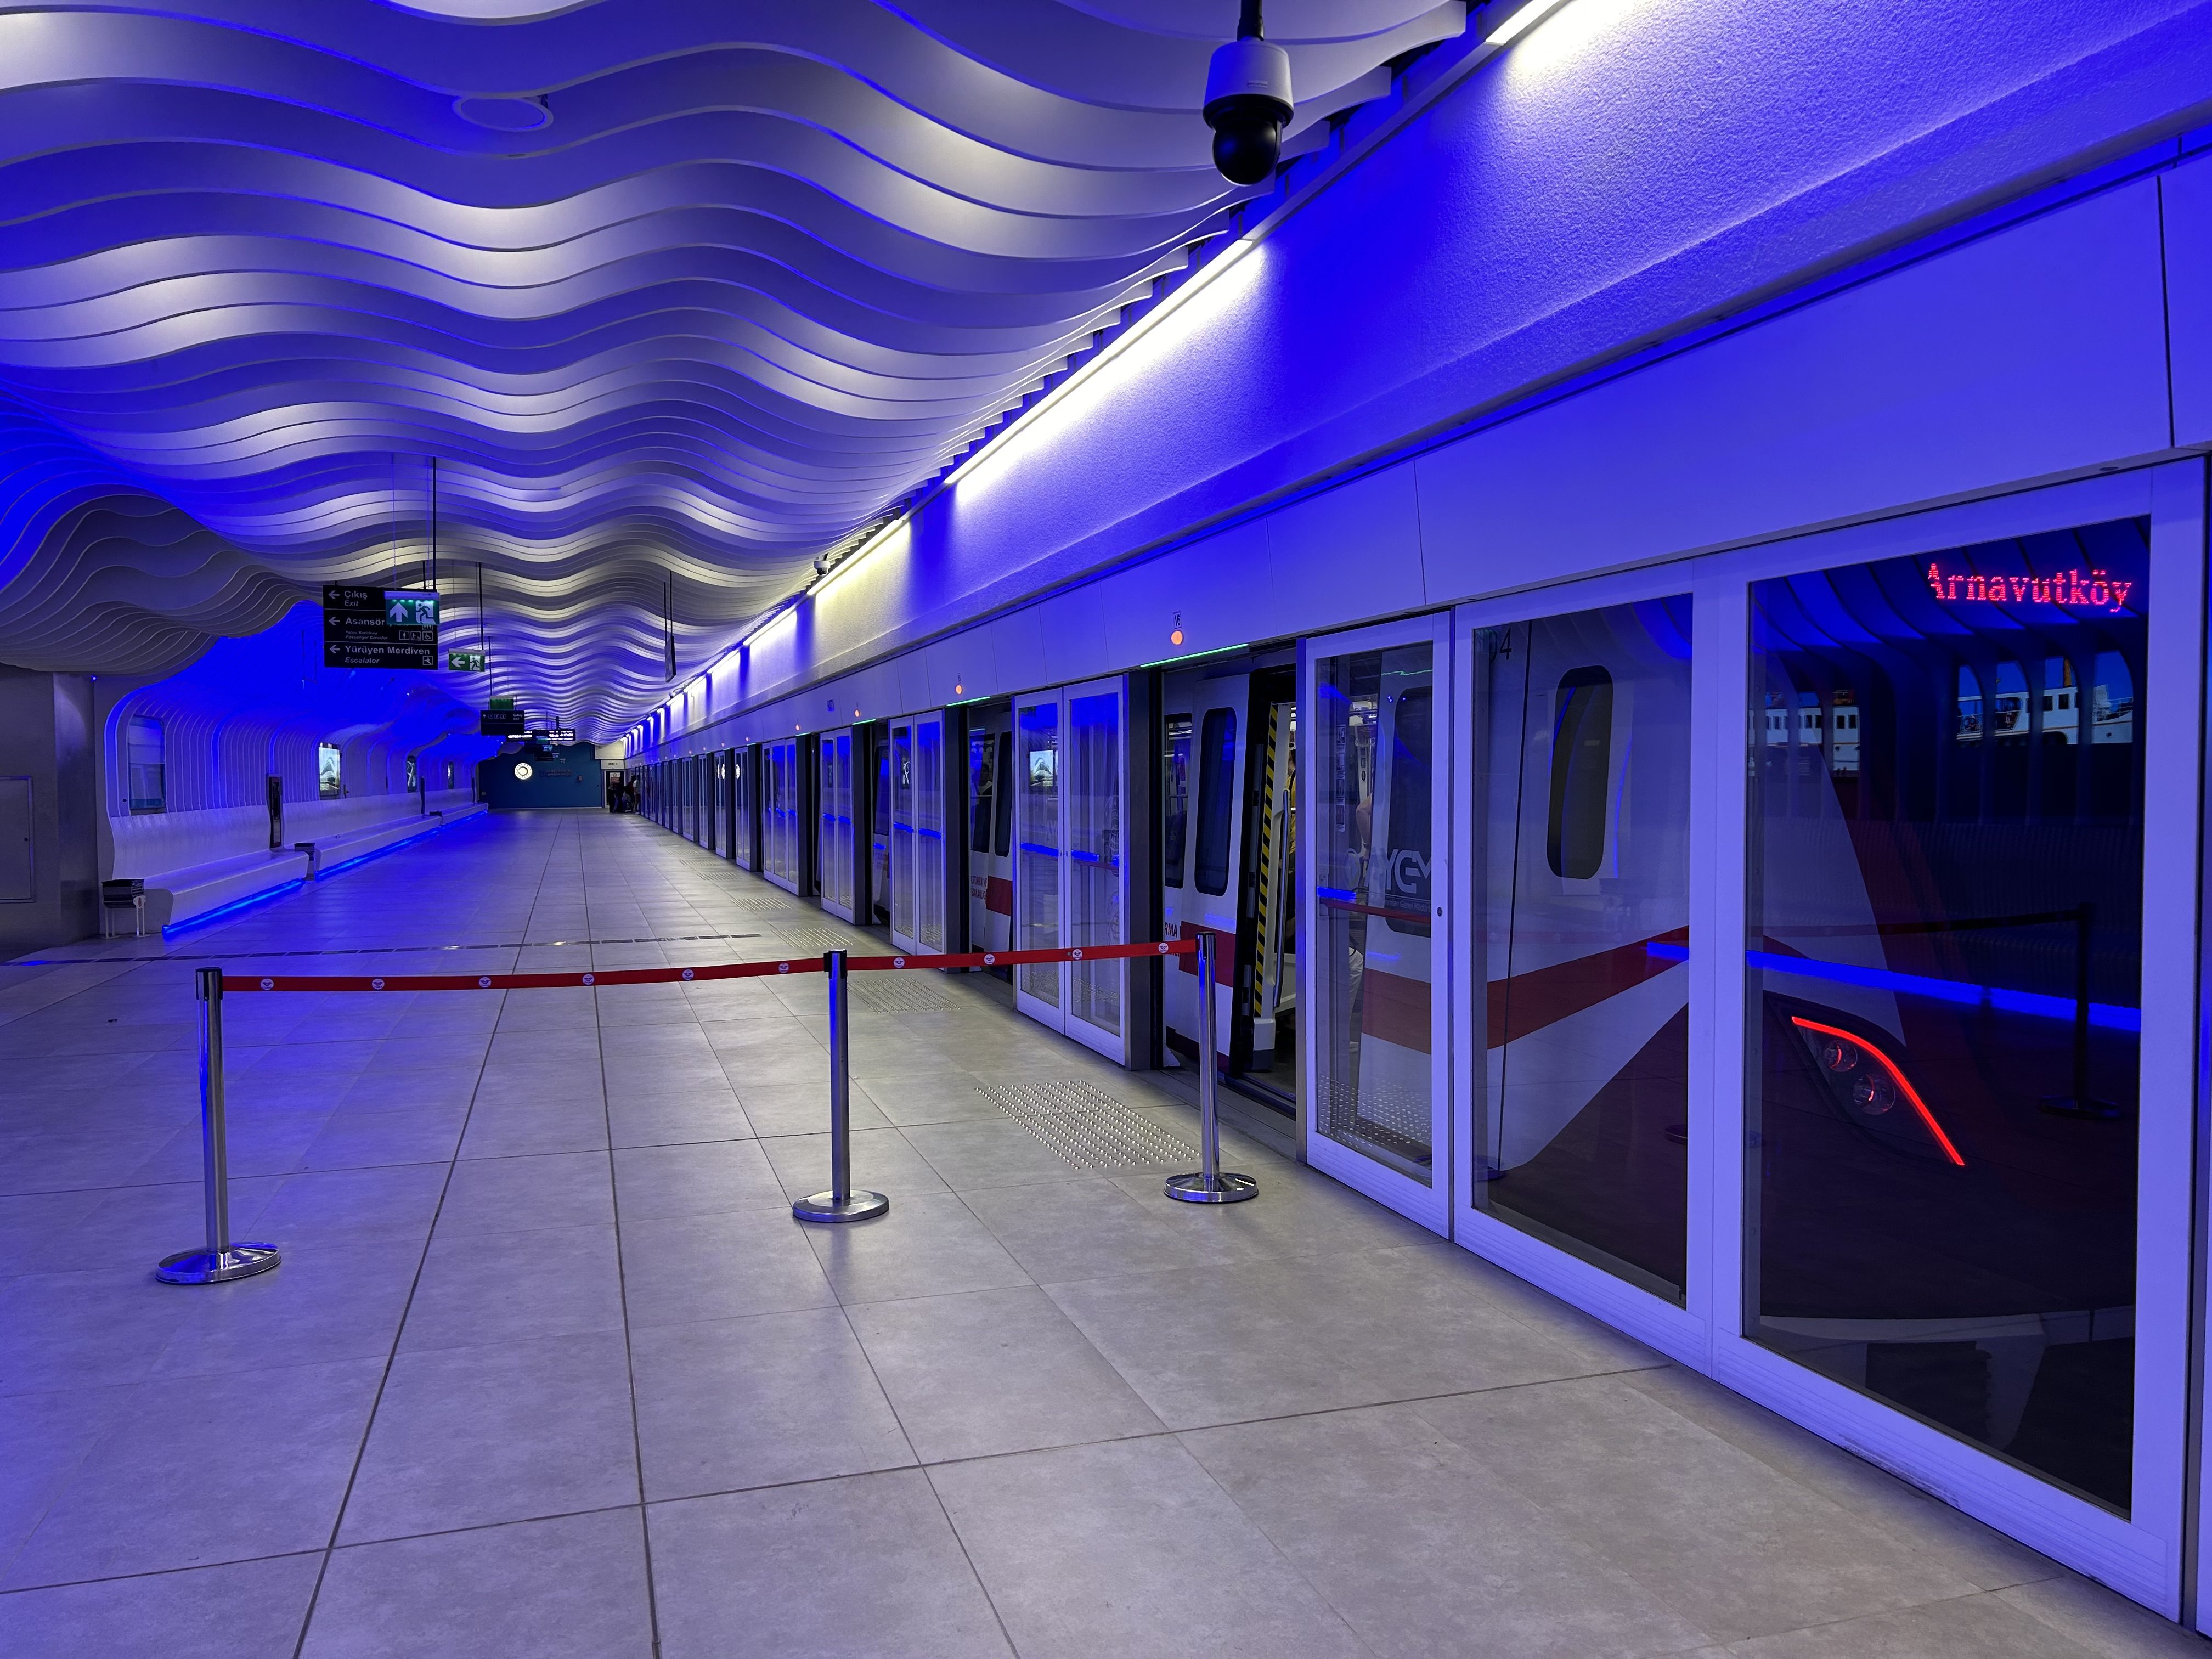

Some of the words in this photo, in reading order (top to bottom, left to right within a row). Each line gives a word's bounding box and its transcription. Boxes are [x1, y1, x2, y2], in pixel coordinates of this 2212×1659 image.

[1928, 563, 2132, 612] Arnavutköy
[345, 590, 368, 600] Çıkış
[345, 617, 385, 626] Asansör
[1175, 614, 1181, 627] 16
[345, 645, 384, 655] Yürüyen
[387, 646, 430, 655] Merdiven
